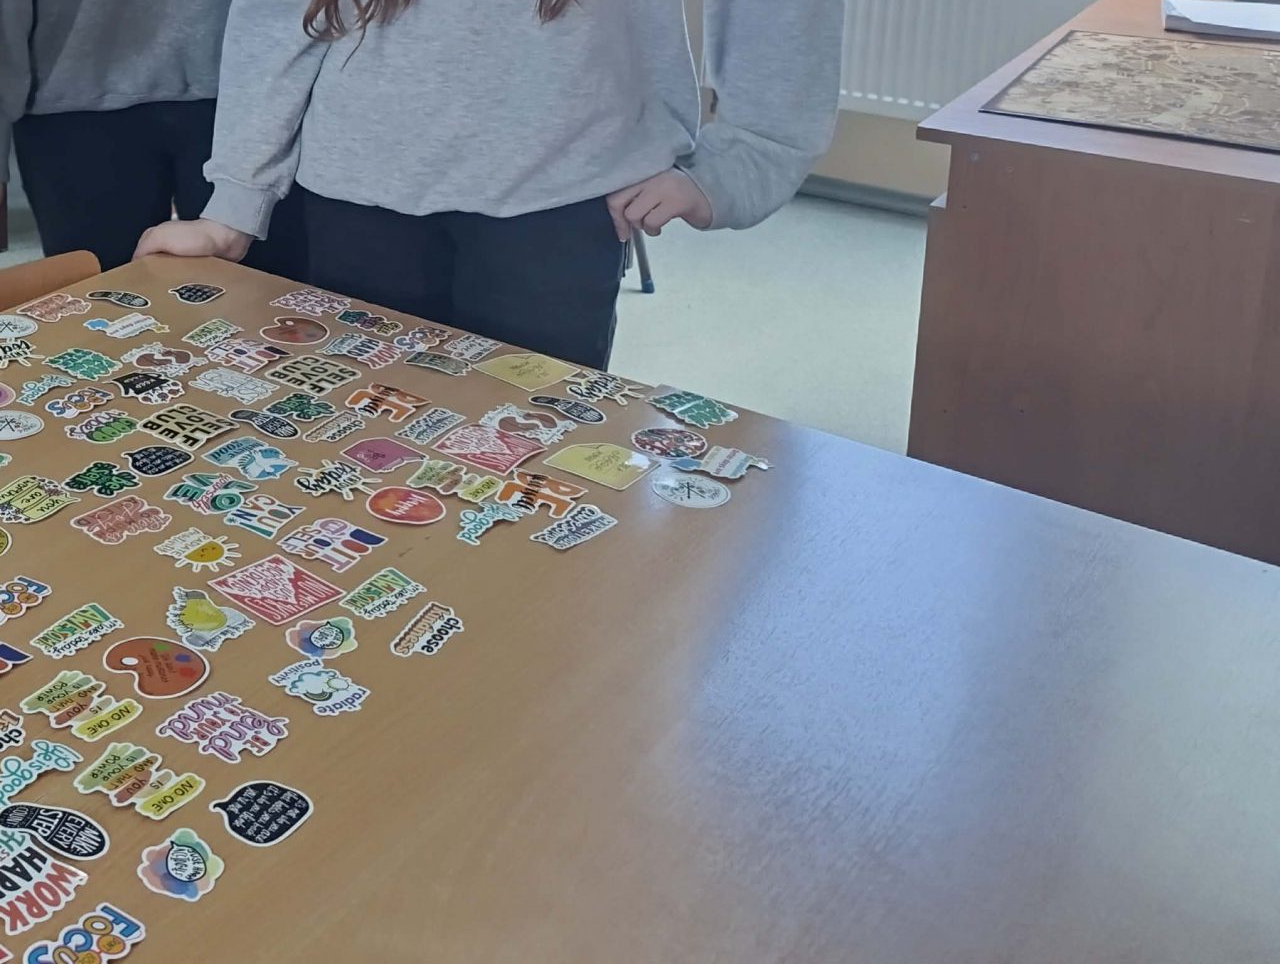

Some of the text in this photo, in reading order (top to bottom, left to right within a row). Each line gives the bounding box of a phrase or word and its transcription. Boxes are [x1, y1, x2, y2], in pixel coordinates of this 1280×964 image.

[347, 338, 379, 357] HARD
[271, 358, 319, 379] CLUB
[287, 361, 339, 386] LOVE
[308, 368, 356, 393] SELF
[143, 405, 197, 430] CLUB
[158, 412, 215, 439] LOVE
[182, 419, 234, 447] SELF
[297, 462, 357, 492] today
[21, 492, 41, 503] are
[239, 504, 302, 537] YOU!
[283, 526, 320, 551] SELF
[394, 604, 449, 655] kindness
[421, 618, 461, 653] choose
[272, 659, 320, 683] positivity
[36, 682, 67, 701] POWER
[317, 688, 367, 714] radiate
[68, 702, 87, 717] YOU
[87, 706, 130, 734] NO ONE
[90, 705, 102, 713] IS
[160, 693, 237, 740] mind
[202, 712, 284, 761] kind
[90, 755, 120, 778] POWER
[102, 764, 125, 781] YOUR
[134, 759, 154, 772] AND
[126, 778, 146, 794] YOU
[150, 780, 164, 789] IS
[152, 781, 193, 811] NO ONE
[30, 808, 62, 837] STEP
[53, 817, 84, 849] EVERY
[70, 827, 100, 854] MAKE
